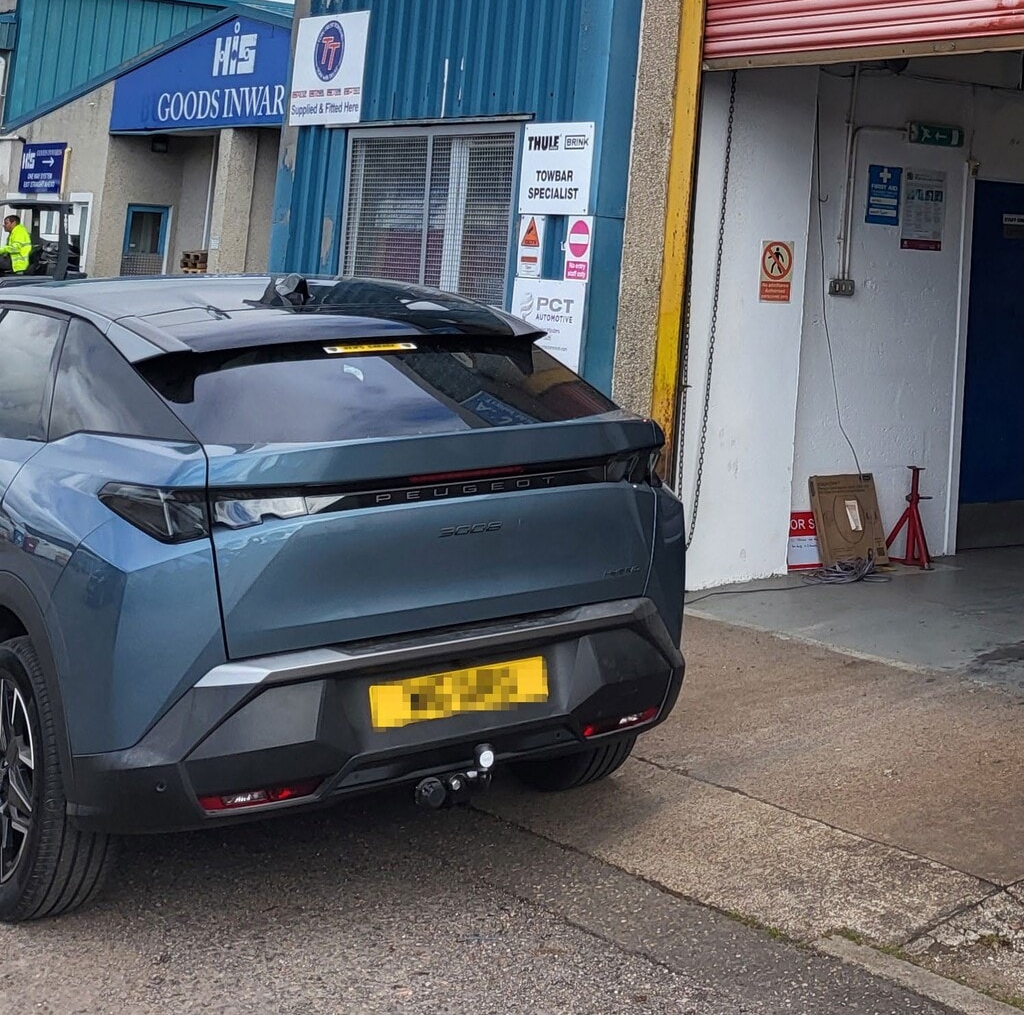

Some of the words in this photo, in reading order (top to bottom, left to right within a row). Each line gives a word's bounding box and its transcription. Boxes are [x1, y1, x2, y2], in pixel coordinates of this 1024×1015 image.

[157, 90, 220, 122] GOODS
[222, 84, 286, 118] INWAR
[291, 103, 318, 117] Supplied
[319, 103, 324, 114] &
[325, 102, 342, 113] Fitted
[344, 101, 359, 112] Here
[528, 136, 560, 151] THULE
[566, 138, 589, 147] BRINK
[536, 170, 574, 182] TOWBAR
[528, 187, 579, 199] SPECIALIST
[536, 297, 574, 313] PCT
[535, 313, 573, 324] AUTOMOTIVE
[375, 476, 555, 503] PEUGEOT
